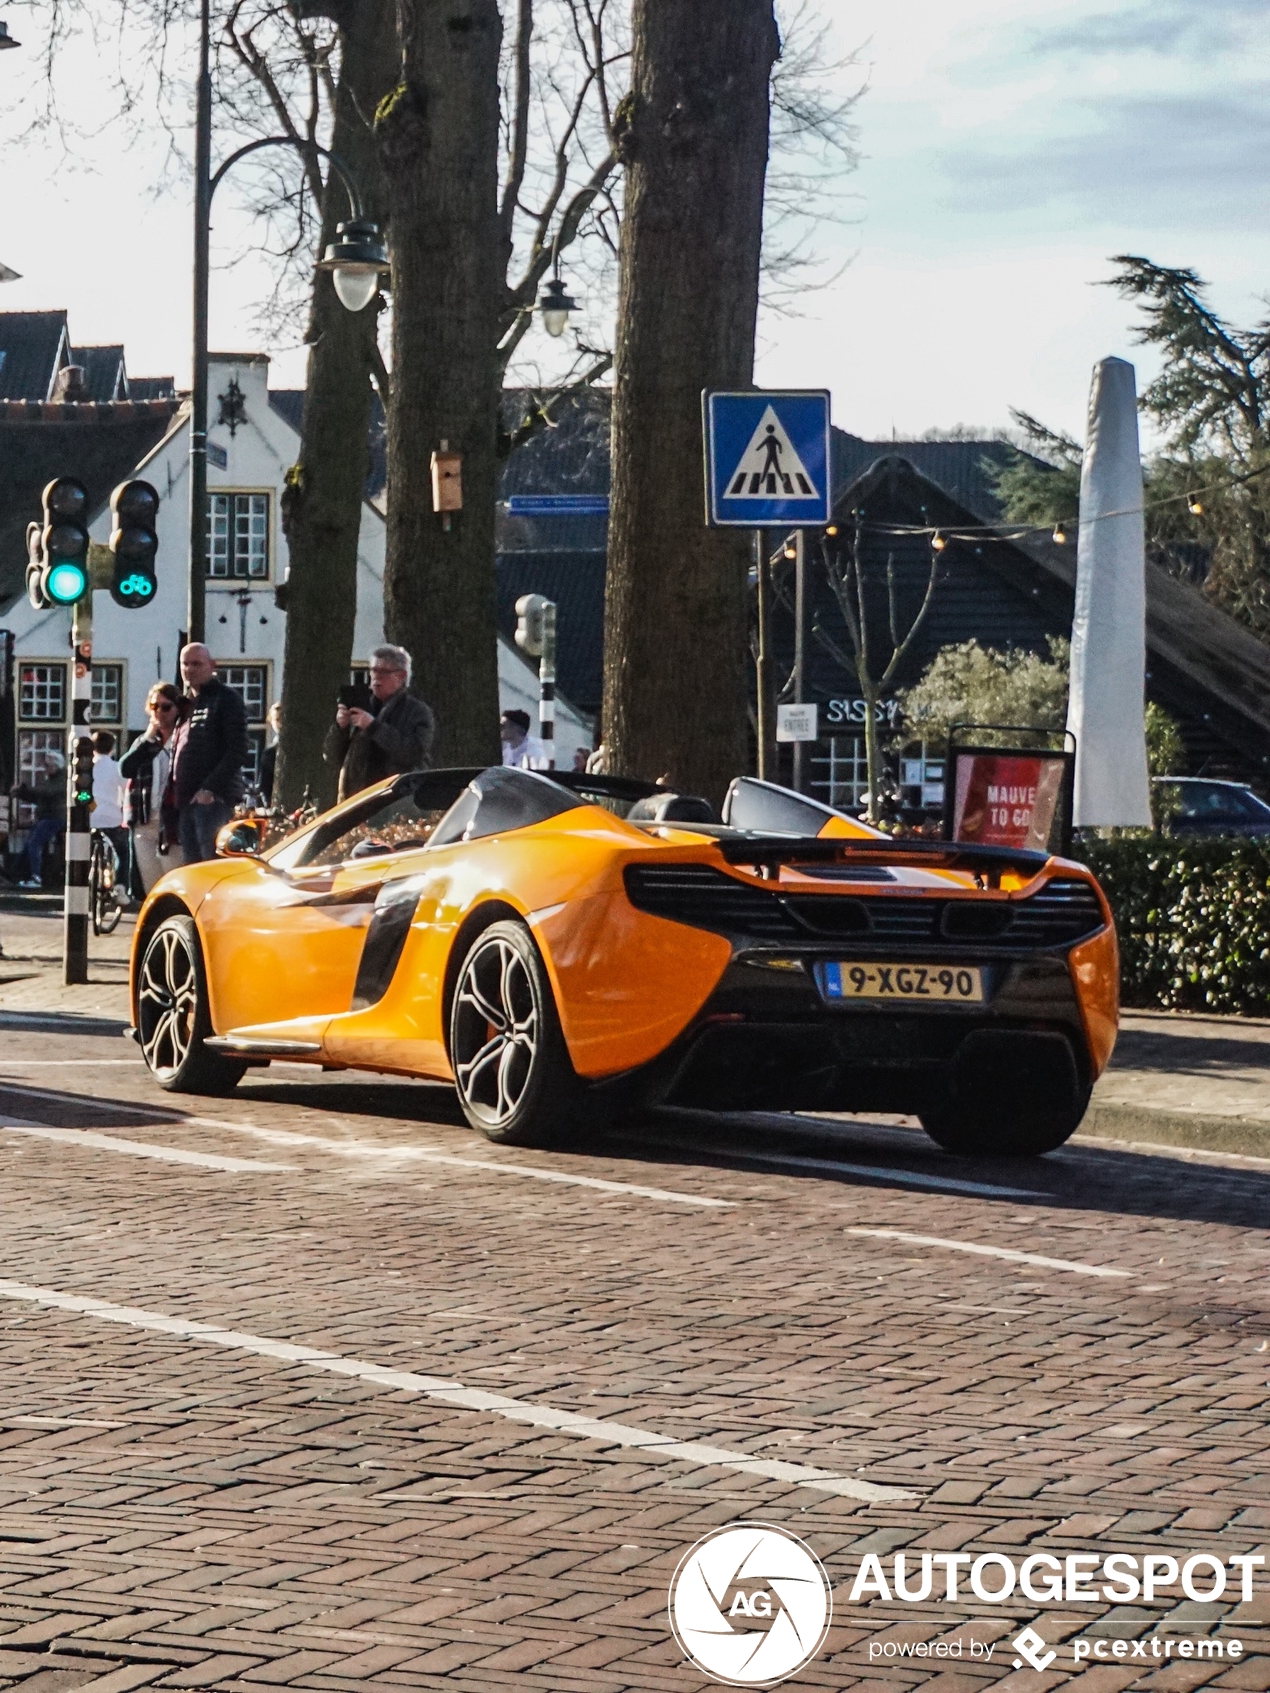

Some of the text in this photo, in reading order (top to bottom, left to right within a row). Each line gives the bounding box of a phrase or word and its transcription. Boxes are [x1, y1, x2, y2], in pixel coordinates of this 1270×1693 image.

[987, 785, 1037, 805] MAUVE
[991, 808, 1031, 828] TO GO
[849, 966, 973, 996] 9-XGZ-90
